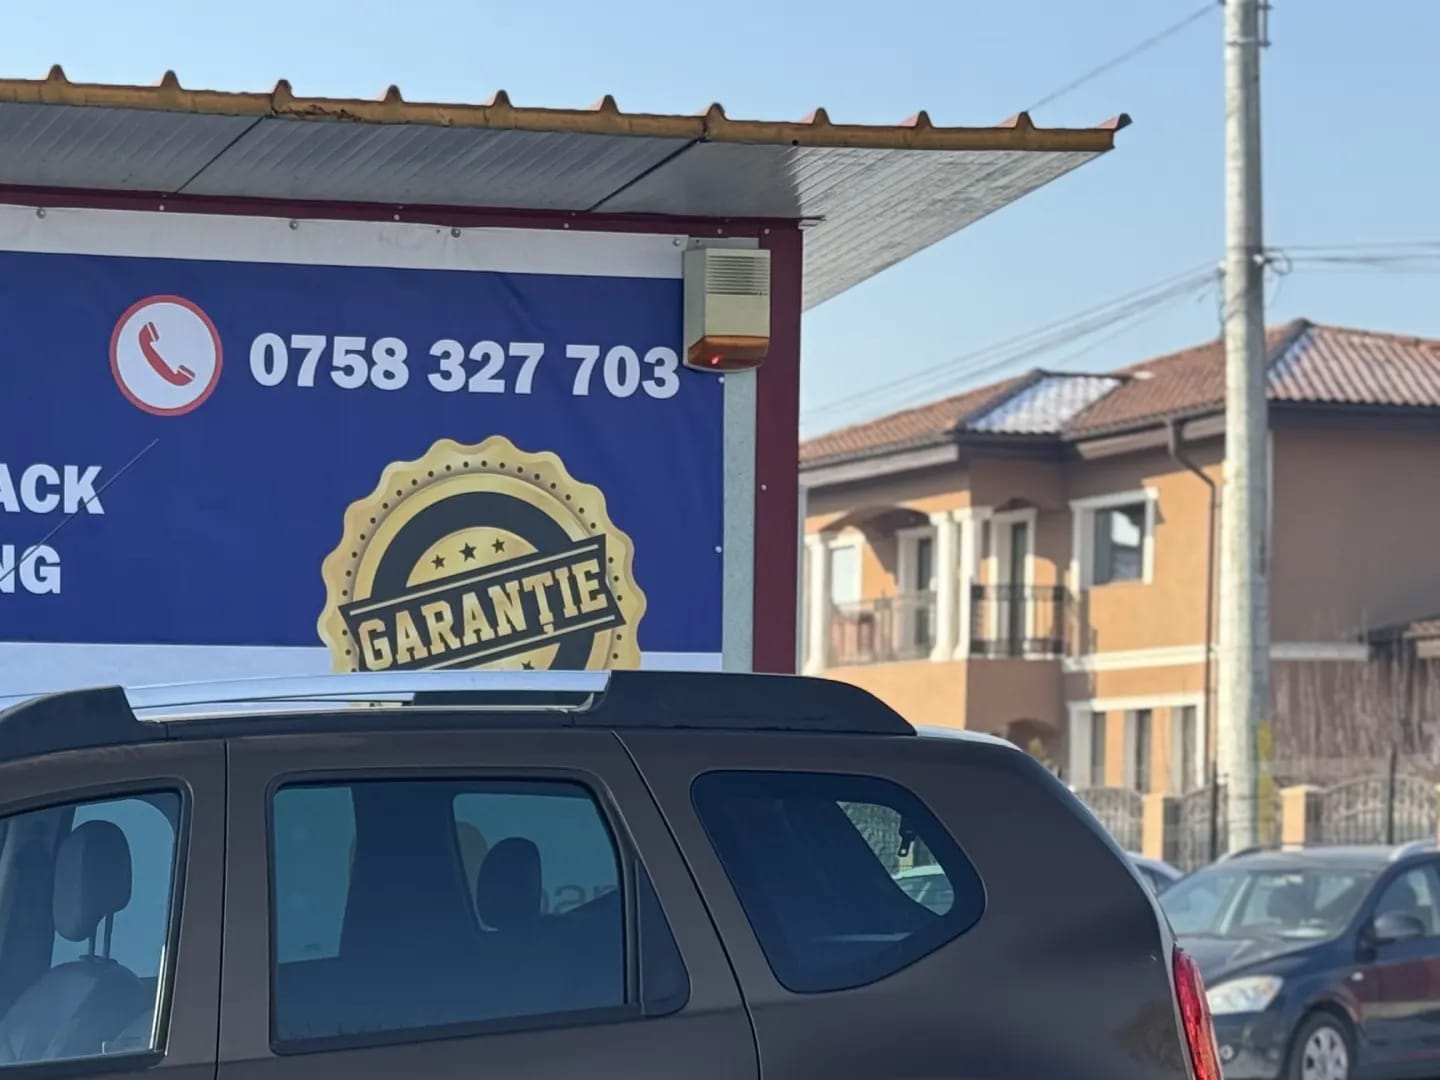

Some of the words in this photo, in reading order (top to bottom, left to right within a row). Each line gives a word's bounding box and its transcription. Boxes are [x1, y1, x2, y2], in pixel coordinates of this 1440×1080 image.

[249, 332, 409, 390] 0758
[427, 339, 545, 394] 327
[566, 344, 680, 399] 703
